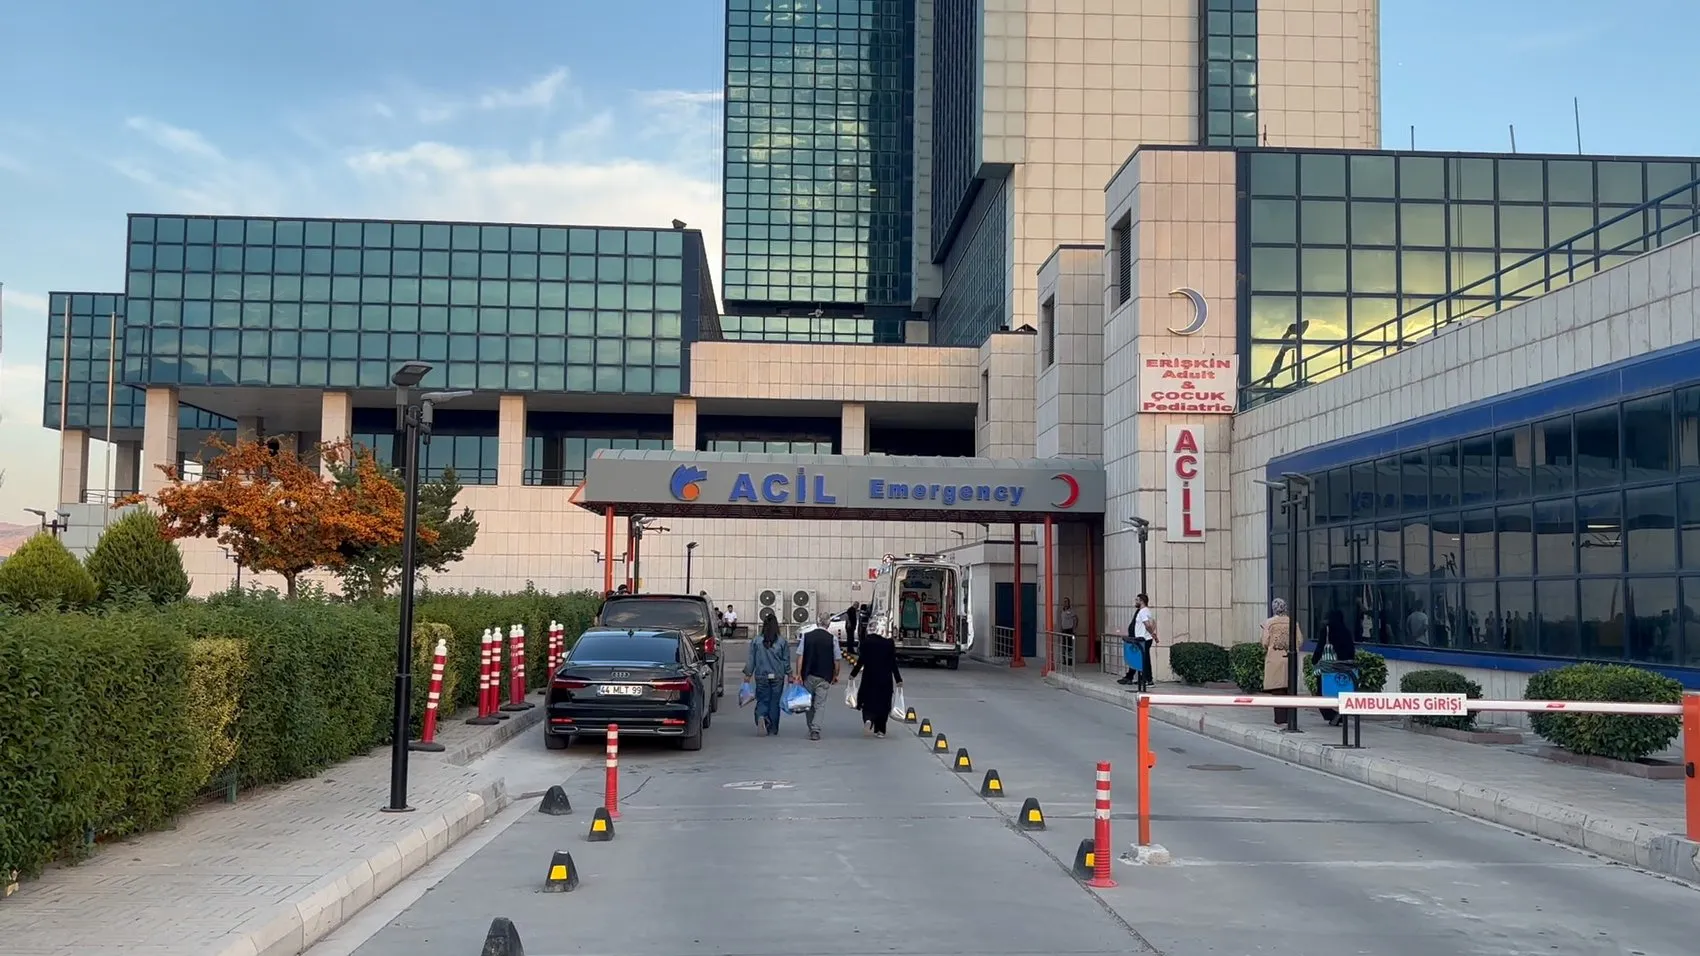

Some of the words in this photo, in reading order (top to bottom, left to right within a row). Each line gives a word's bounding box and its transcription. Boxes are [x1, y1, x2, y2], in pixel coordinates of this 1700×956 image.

[1146, 358, 1230, 370] ERİŞKİN
[1181, 381, 1195, 389] &
[1151, 392, 1225, 402] ÇOCUK
[1143, 402, 1233, 411] Pediatric
[728, 467, 836, 505] ACİL
[869, 479, 1024, 506] Emergency
[1173, 429, 1202, 537] ACİL
[613, 686, 629, 694] MLT
[632, 686, 641, 695] 99
[1345, 698, 1420, 710] AMBULANS
